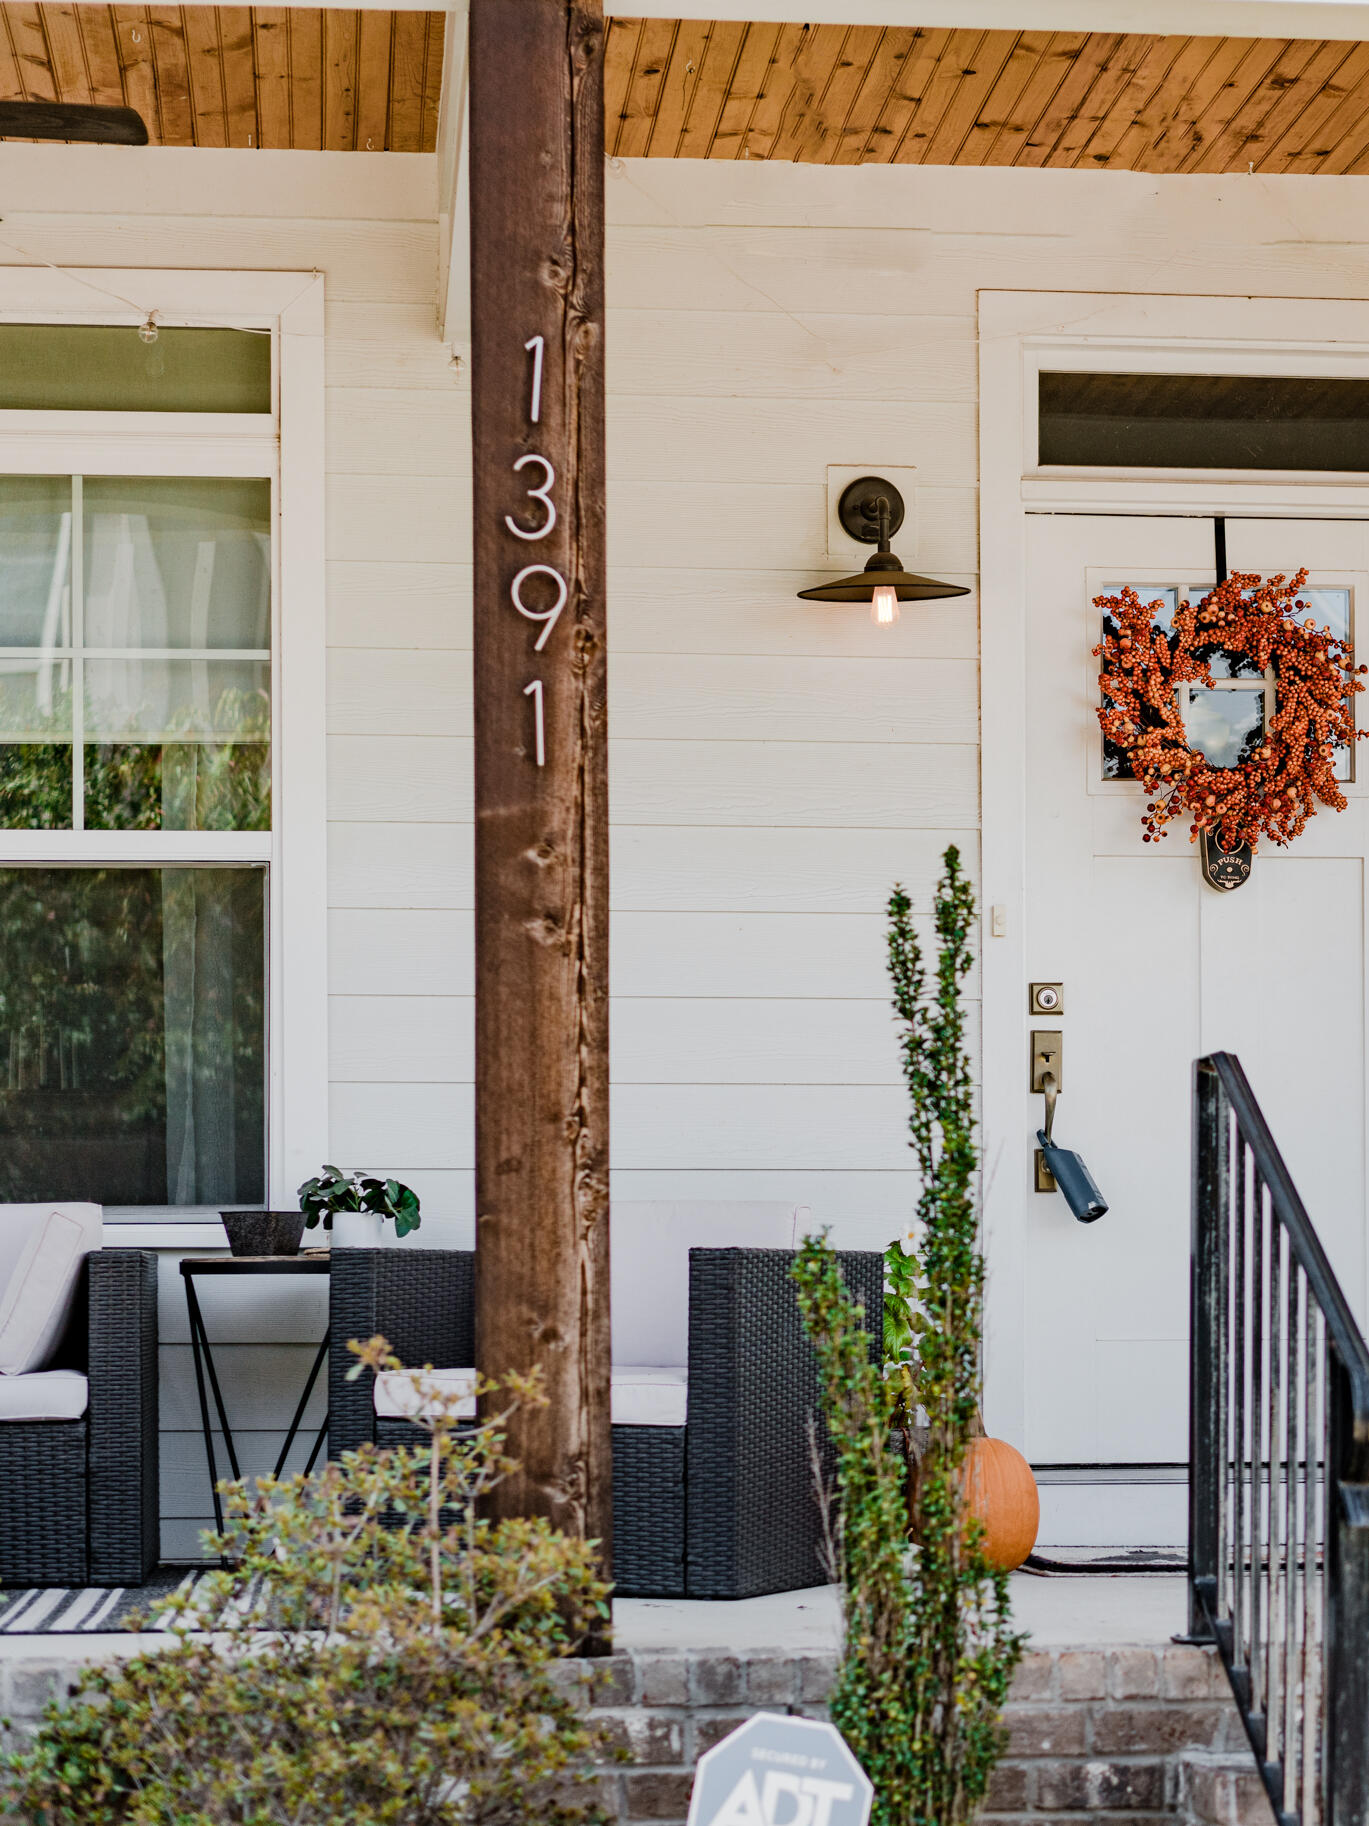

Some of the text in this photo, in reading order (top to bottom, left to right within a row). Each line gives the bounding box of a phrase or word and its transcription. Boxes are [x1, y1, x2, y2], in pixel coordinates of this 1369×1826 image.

[504, 335, 568, 767] 1391
[1217, 856, 1243, 866] PUSH
[751, 1747, 828, 1769] SECURED BY
[708, 1768, 855, 1826] ADT
